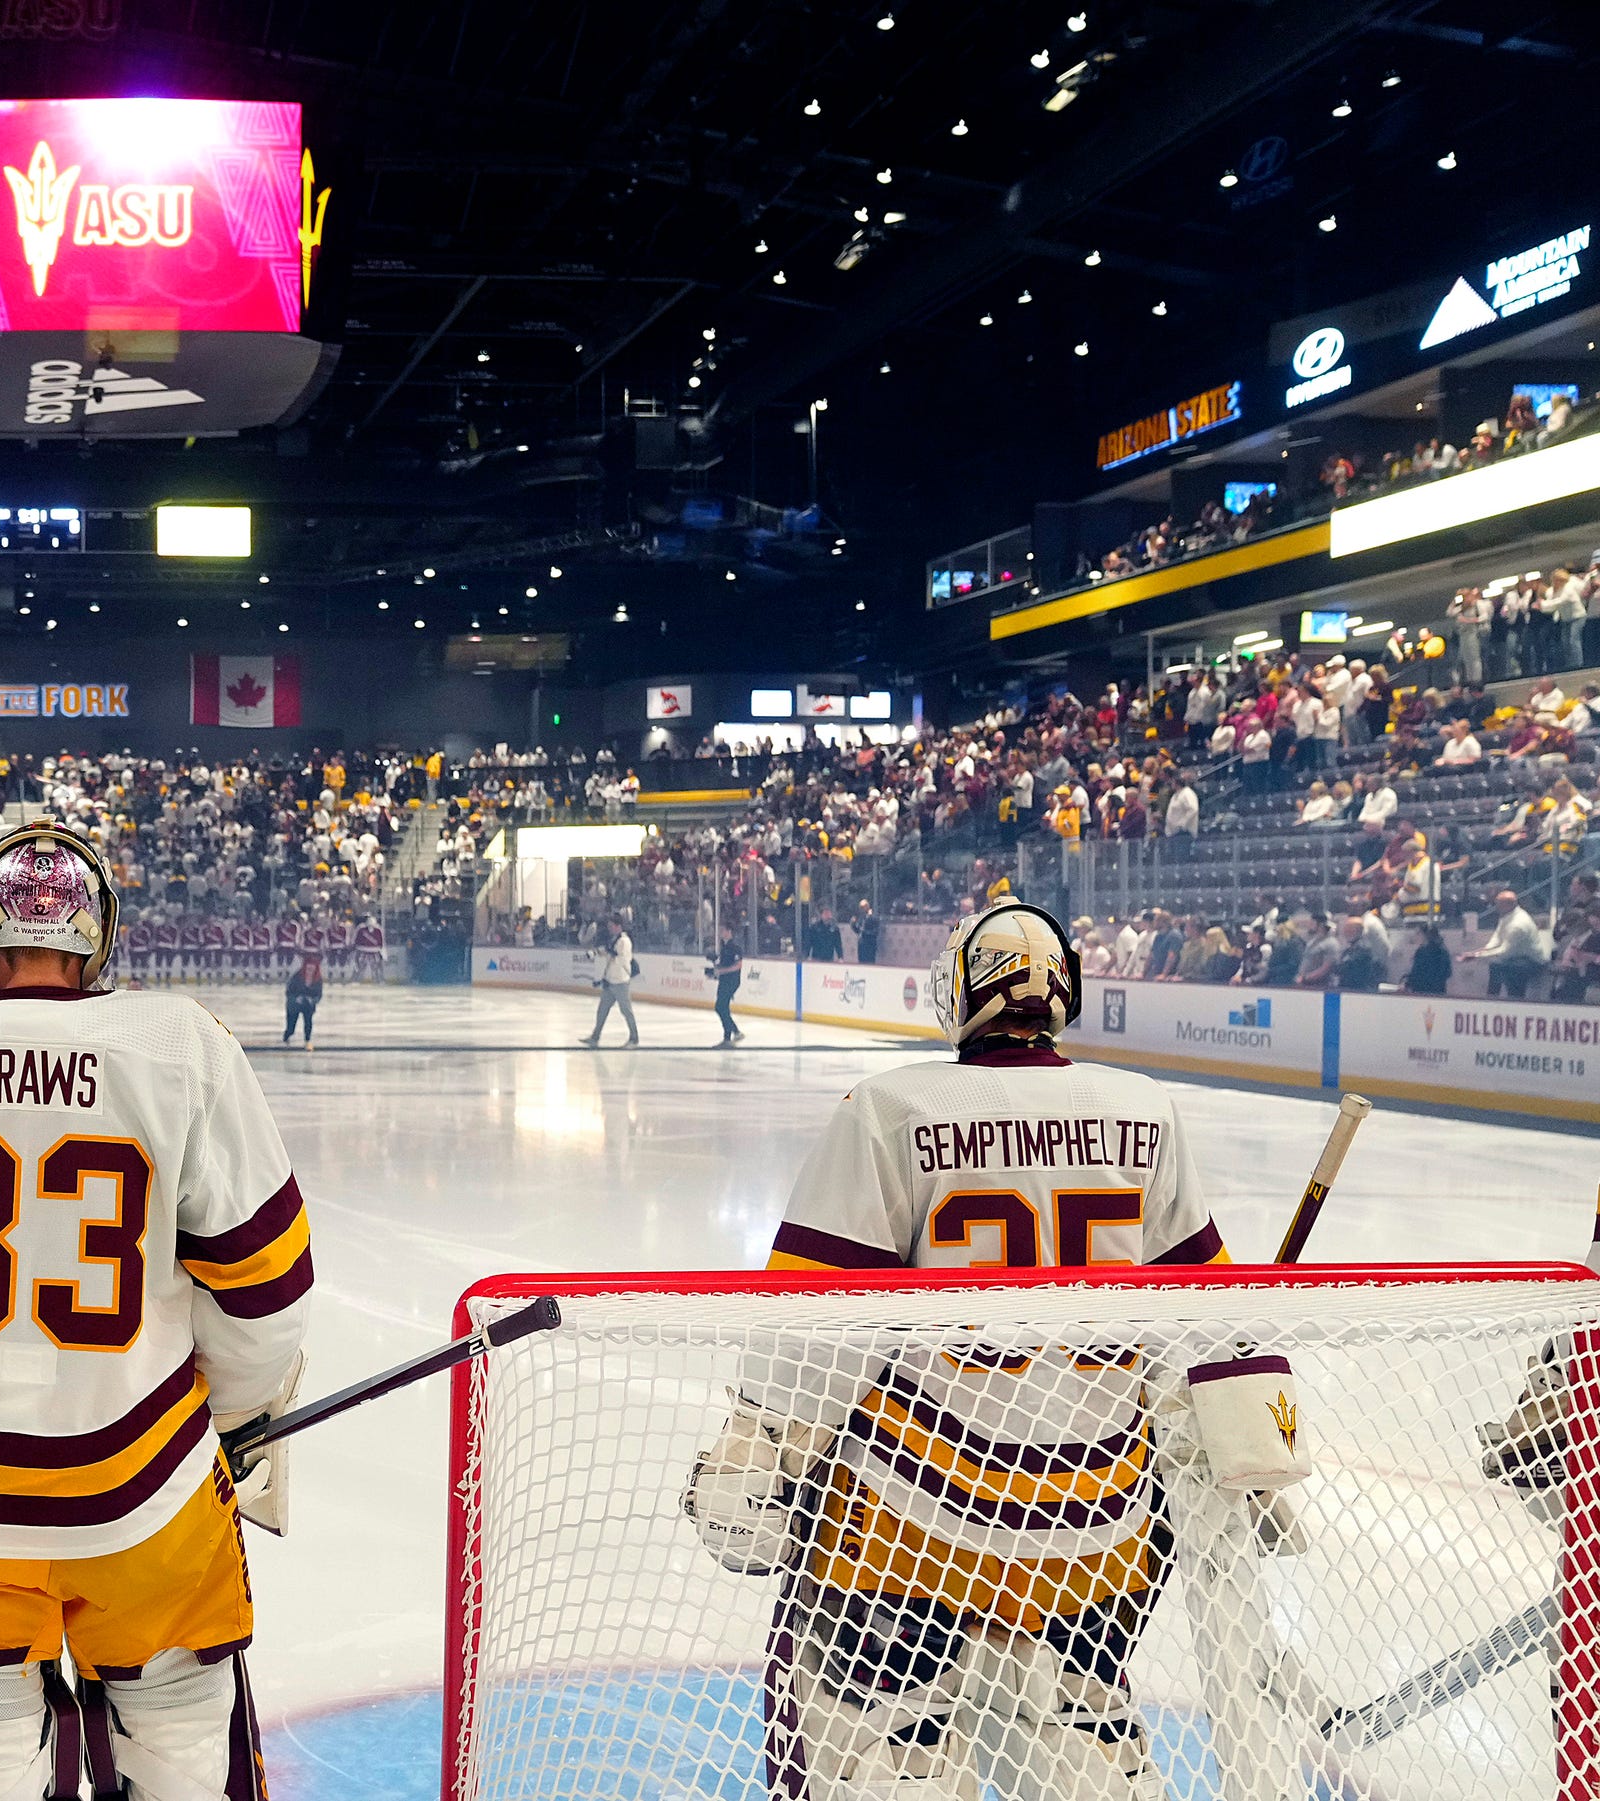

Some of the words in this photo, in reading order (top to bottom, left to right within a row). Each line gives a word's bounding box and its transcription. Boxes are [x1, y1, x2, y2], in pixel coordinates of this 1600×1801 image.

[73, 184, 191, 247] ASU
[1486, 224, 1591, 289] MOUNTAIN
[24, 360, 93, 424] adidas
[1097, 410, 1169, 468] ARIZONA
[1175, 383, 1233, 436] STATE
[42, 684, 129, 717] FORK
[1176, 1020, 1272, 1048] Mortenson
[1454, 1012, 1517, 1038] DILLON
[1475, 1051, 1562, 1075] NOVEMBER
[914, 1119, 1159, 1174] SEMPTIMPHELTER
[213, 1456, 236, 1506] UN
